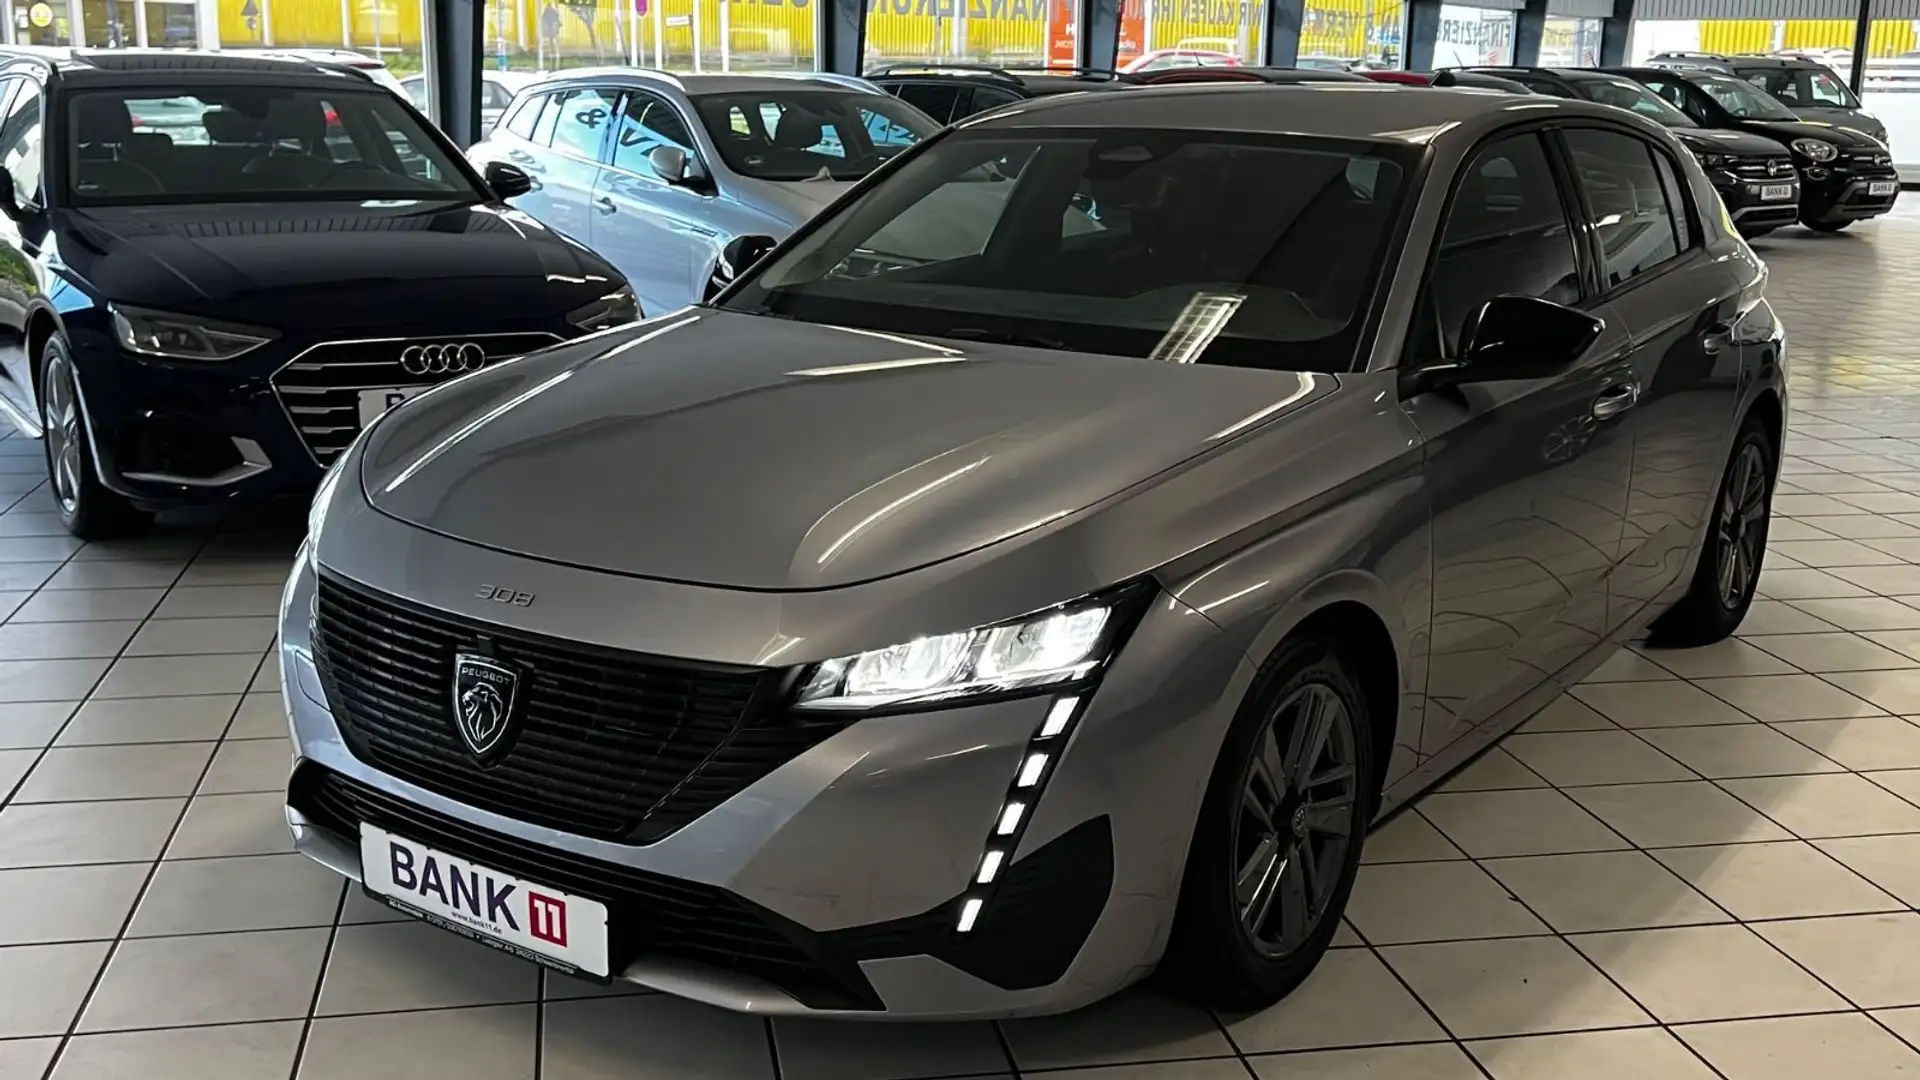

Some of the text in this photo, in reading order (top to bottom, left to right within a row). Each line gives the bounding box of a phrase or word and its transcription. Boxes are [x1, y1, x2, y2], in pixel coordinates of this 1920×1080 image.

[475, 585, 535, 607] 308
[461, 667, 511, 685] PEUGEOT
[389, 841, 563, 942] BANK 11
[451, 911, 502, 934] www.bank11.de
